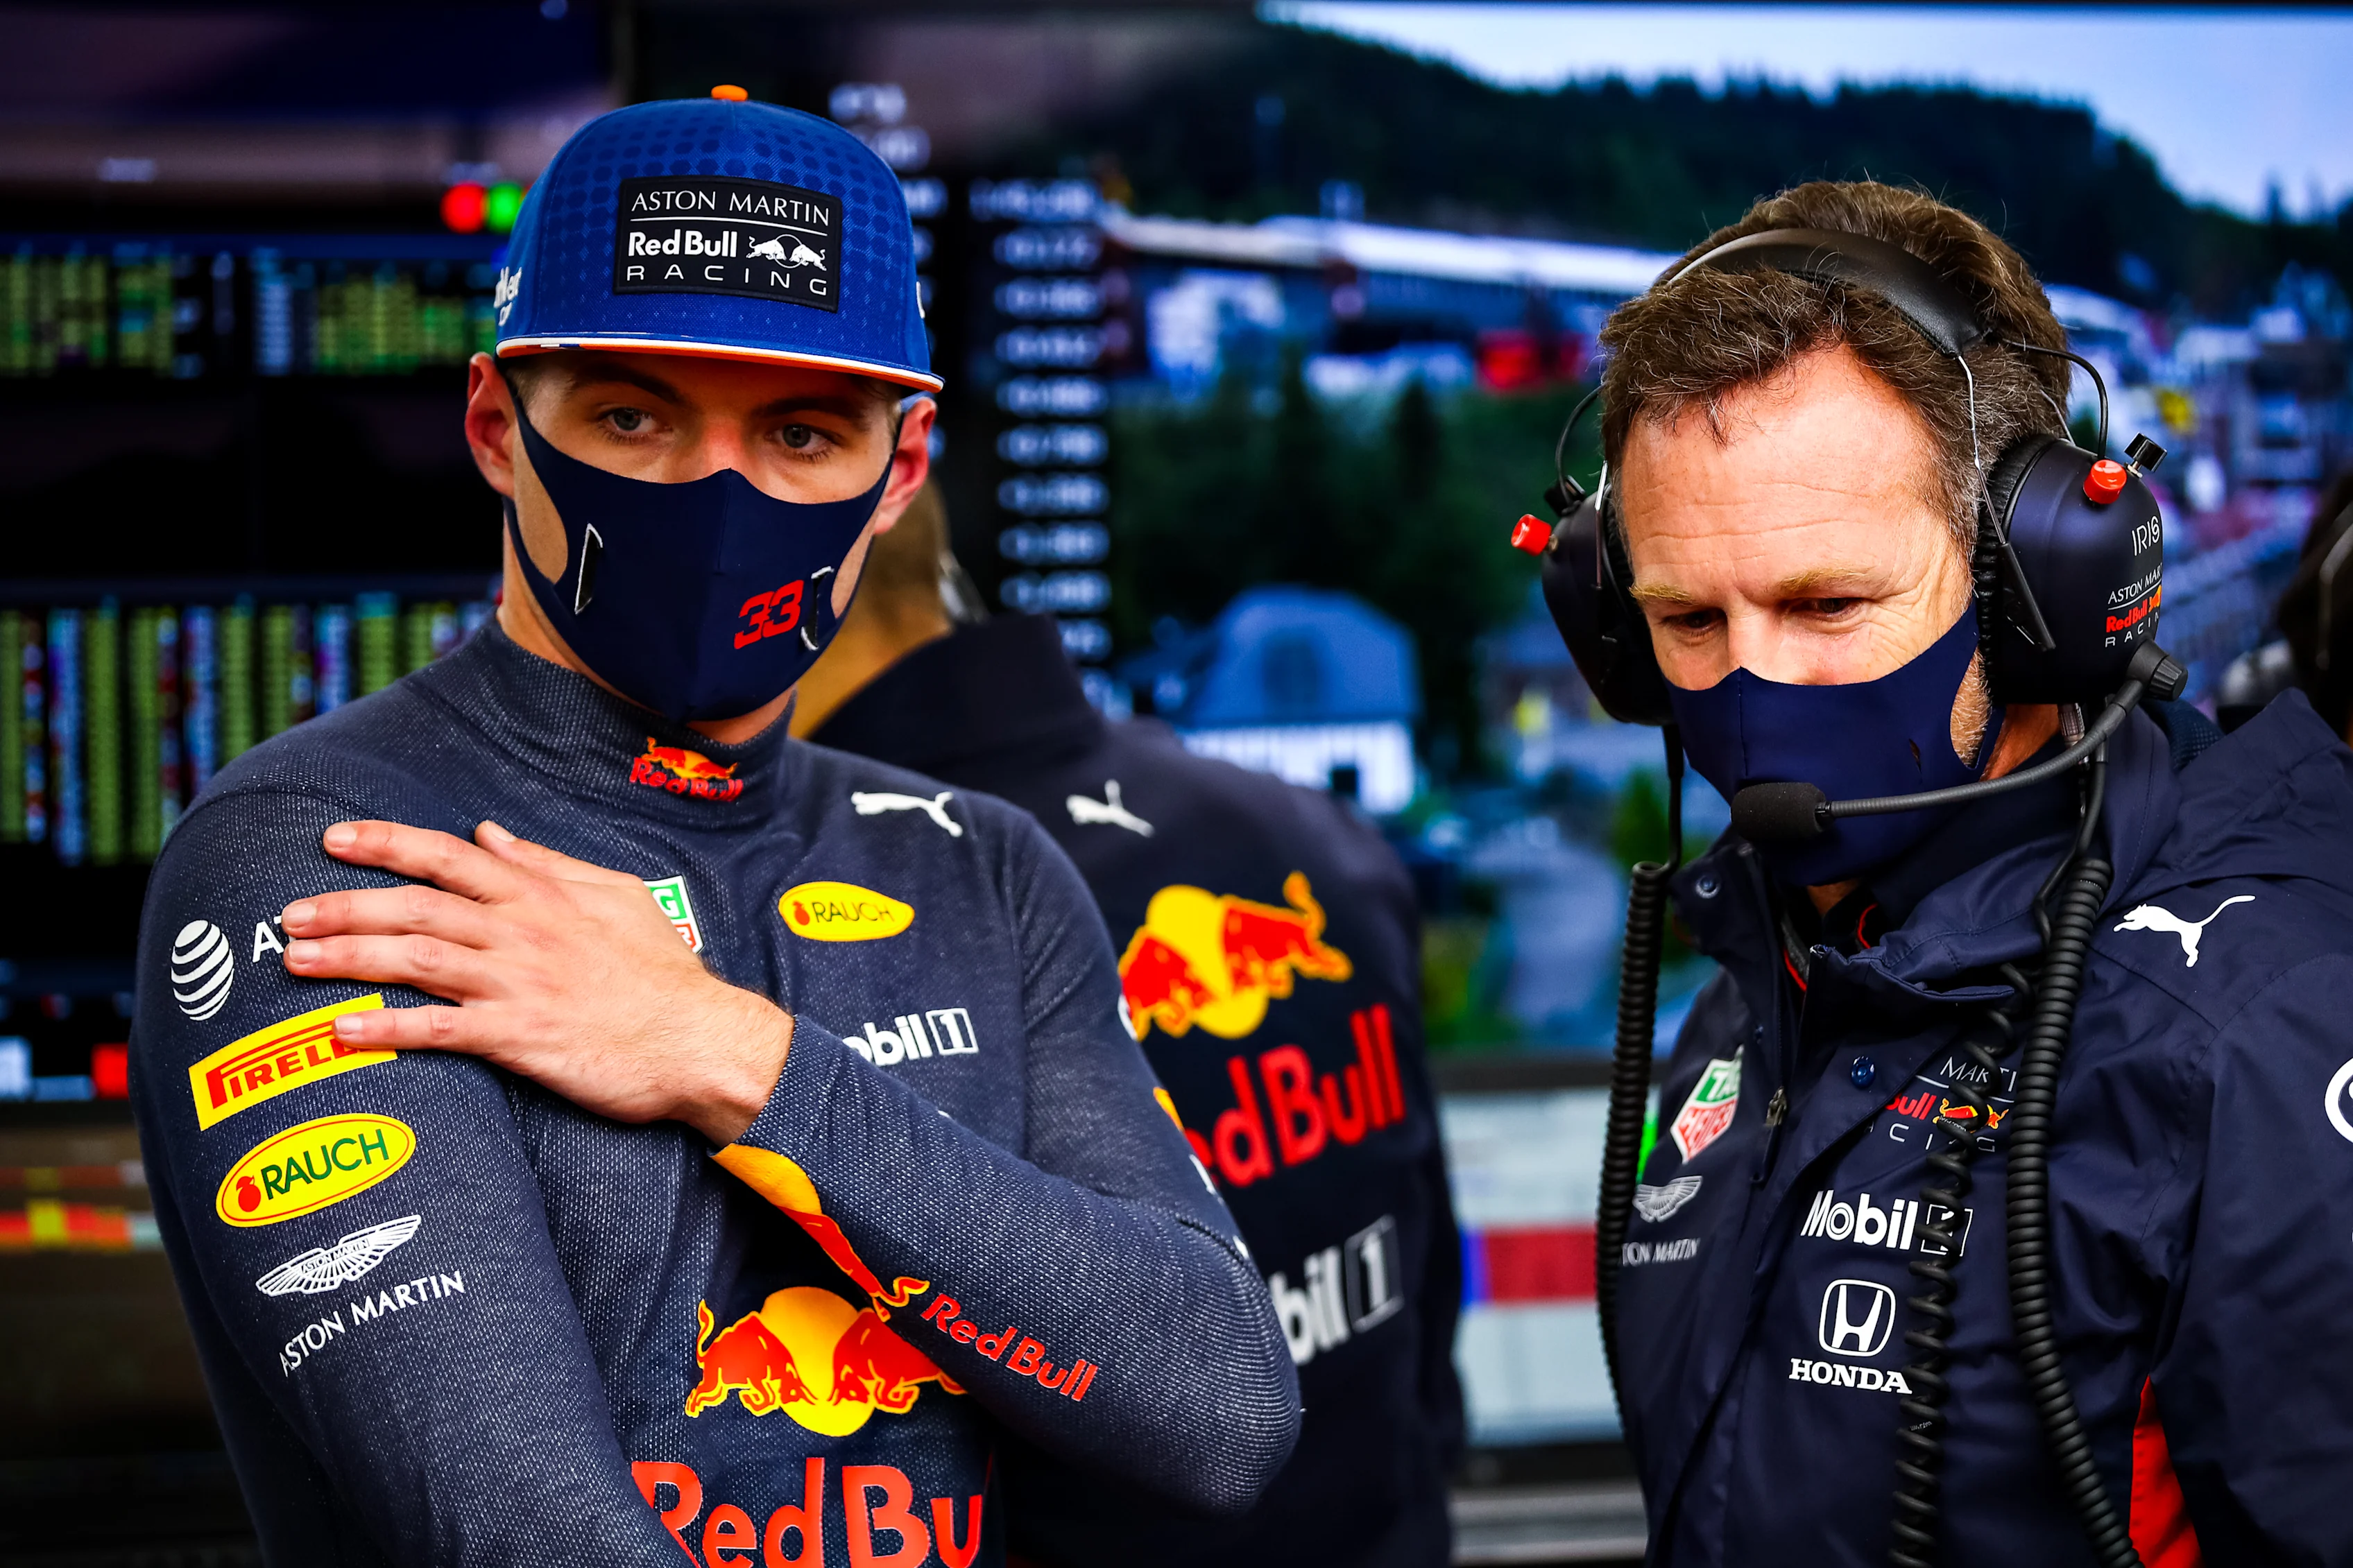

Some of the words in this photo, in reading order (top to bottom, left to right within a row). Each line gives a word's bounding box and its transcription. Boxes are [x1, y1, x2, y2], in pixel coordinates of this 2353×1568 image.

[631, 191, 716, 212] ASTON
[729, 192, 829, 226] MARTIN
[626, 264, 827, 296] RACING
[2107, 578, 2143, 605] ASTON
[2144, 562, 2163, 588] MAR
[733, 579, 805, 650] 33
[2105, 611, 2159, 648] RACIN
[812, 901, 896, 923] RAUCH
[841, 1013, 933, 1067] bil
[205, 1020, 374, 1110] PIRELL
[260, 1129, 390, 1200] RAUCH
[1800, 1189, 1919, 1250] Mobil
[1622, 1241, 1652, 1268] TON
[280, 1311, 346, 1378] ASTON
[350, 1270, 465, 1326] MARTIN
[1269, 1246, 1350, 1365] bil
[1788, 1358, 1913, 1395] HONDA
